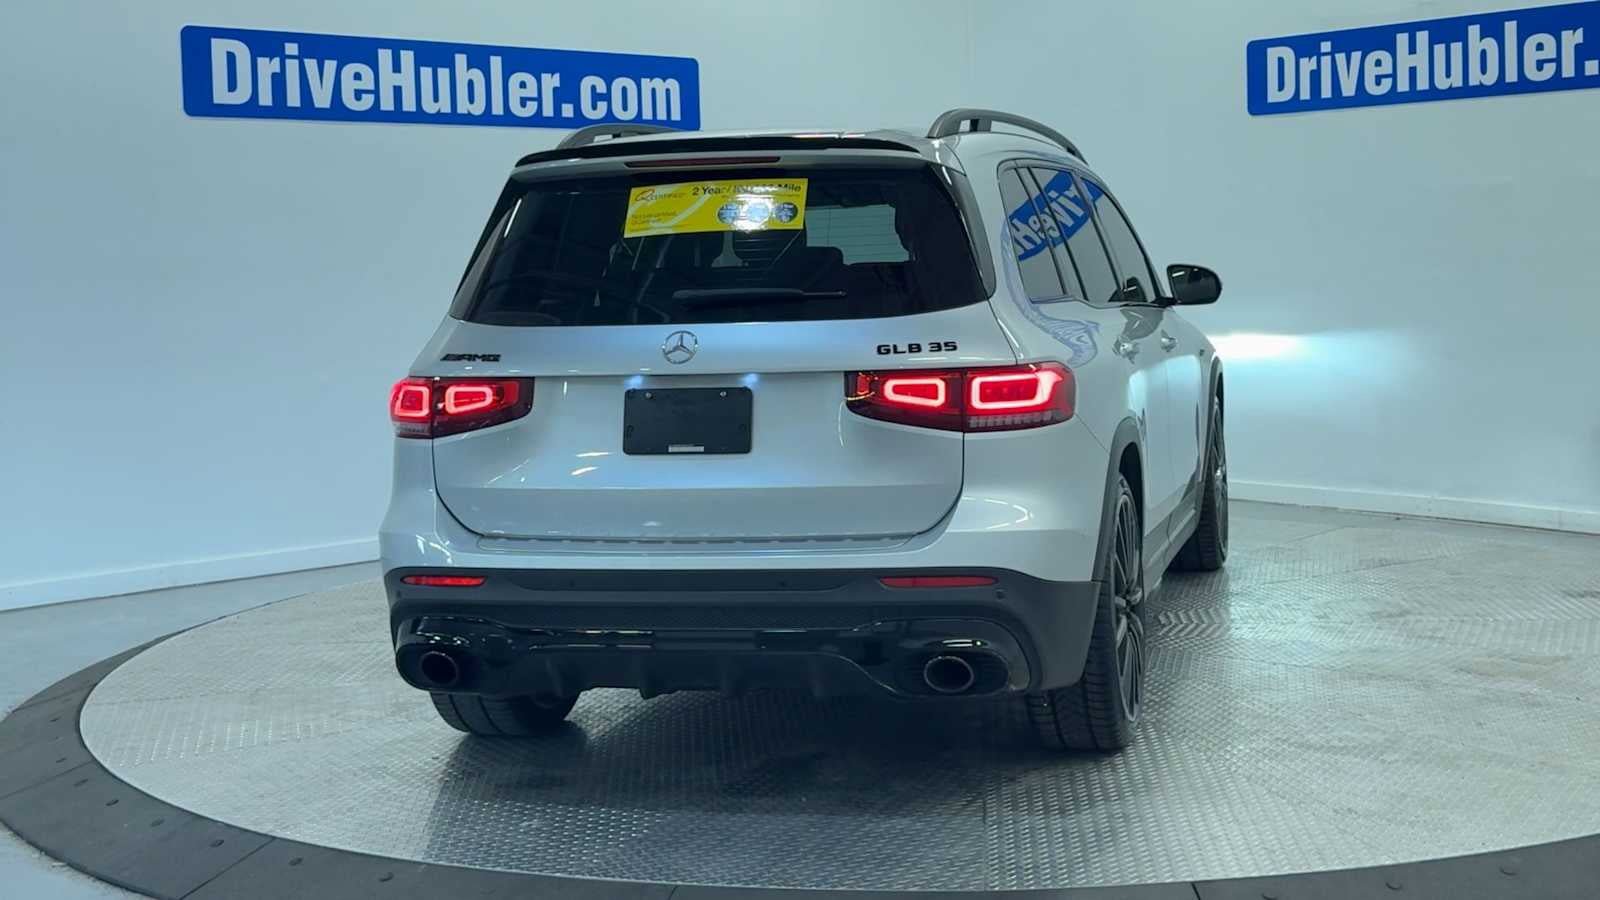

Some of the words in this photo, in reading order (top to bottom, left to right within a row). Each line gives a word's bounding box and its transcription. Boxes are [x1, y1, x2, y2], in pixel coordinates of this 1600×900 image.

[209, 37, 682, 121] DriveHubler.com
[876, 343, 922, 355] GLB
[928, 341, 958, 352] 35
[440, 353, 502, 363] AMG
